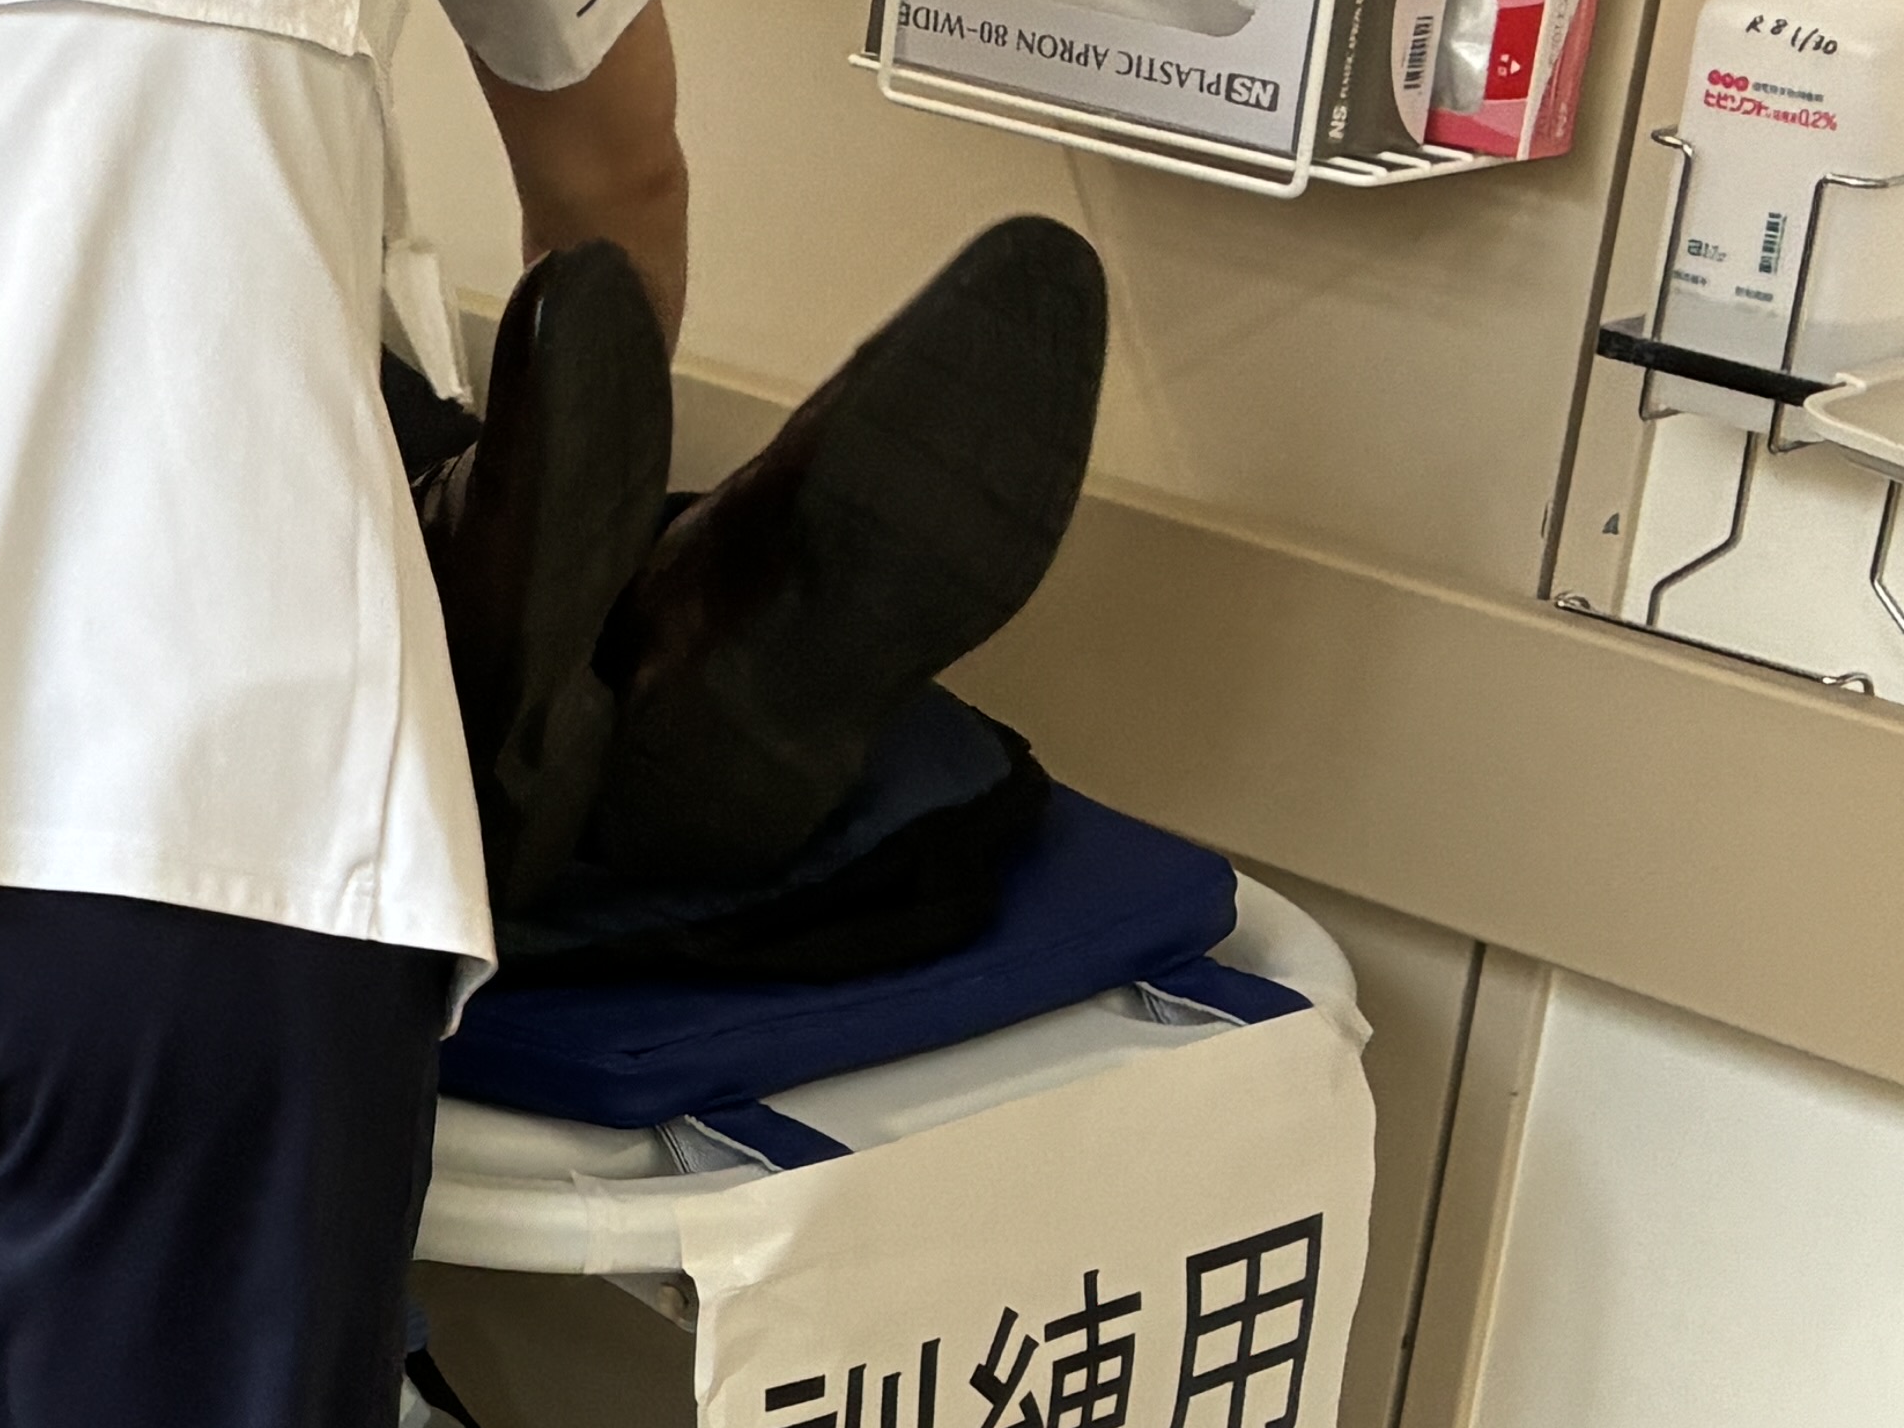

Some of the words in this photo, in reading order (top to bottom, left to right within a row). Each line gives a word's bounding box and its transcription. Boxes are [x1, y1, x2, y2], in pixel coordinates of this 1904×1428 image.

[899, 1, 1008, 47] 80-WIDE
[1016, 28, 1110, 71] APRON
[1115, 50, 1223, 97] PLASTIC
[1229, 76, 1276, 110] NS
[1328, 105, 1348, 140] NS
